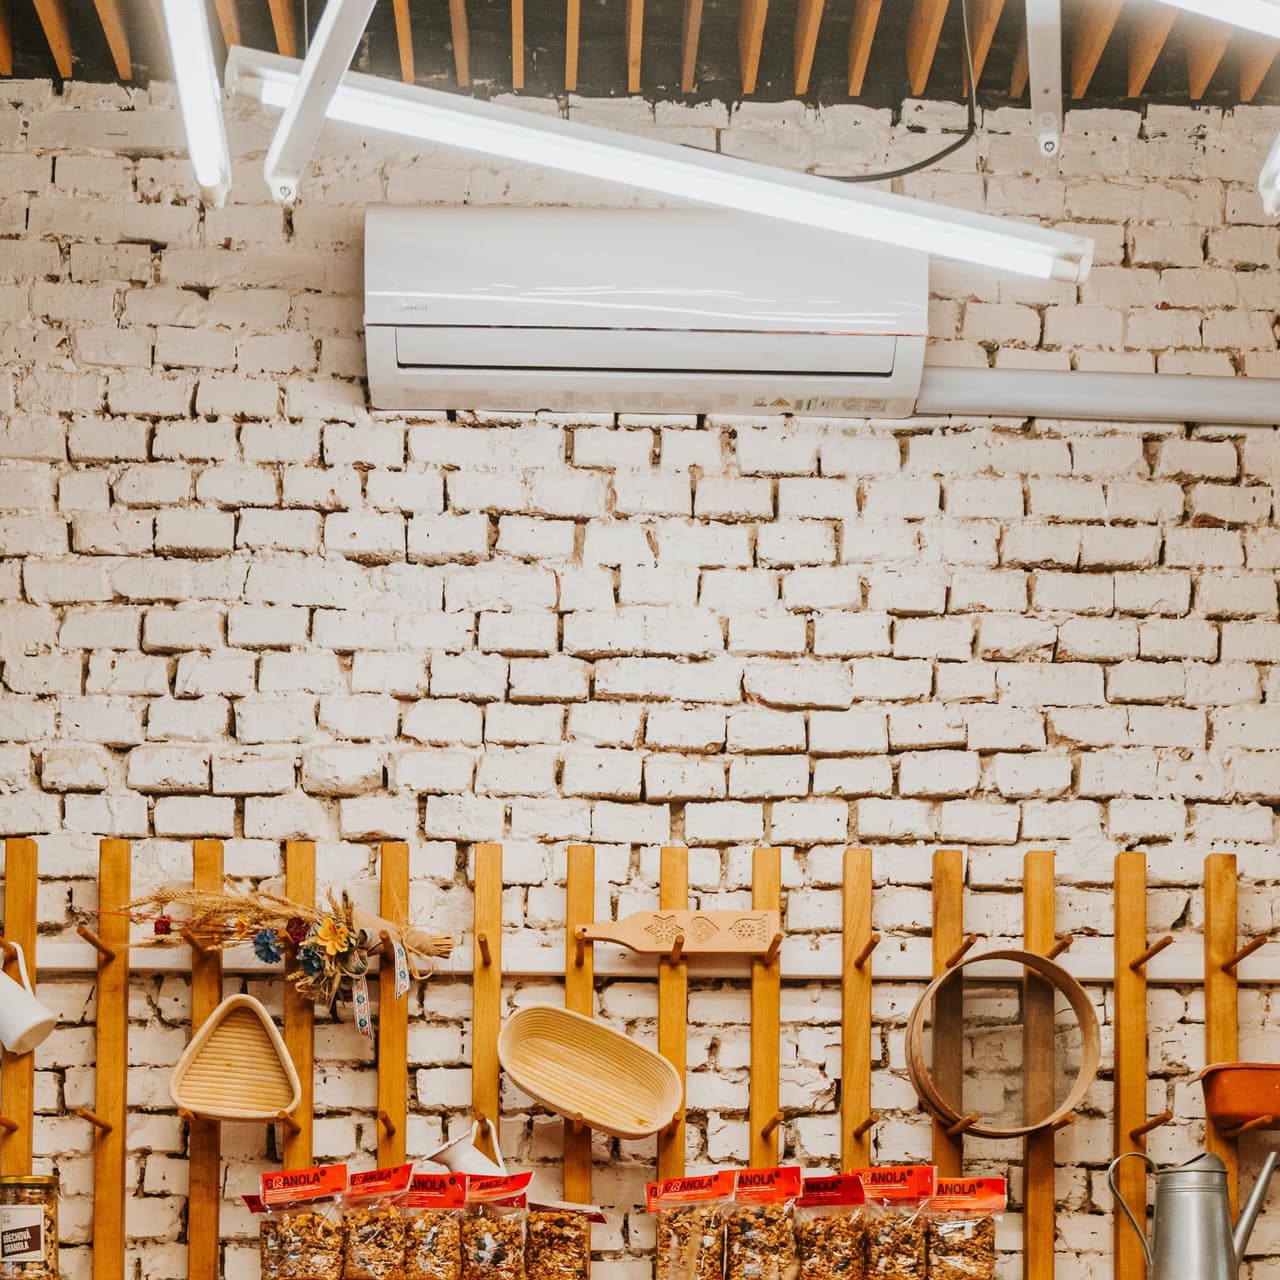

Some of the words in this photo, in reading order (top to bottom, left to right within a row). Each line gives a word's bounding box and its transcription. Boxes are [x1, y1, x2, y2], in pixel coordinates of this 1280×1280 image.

[265, 1173, 320, 1189] GRANOLA
[410, 1175, 446, 1191] ANOLA
[738, 1173, 775, 1186] ANOLA
[937, 1183, 976, 1195] ANOLA
[4, 1241, 30, 1254] GRANOLA
